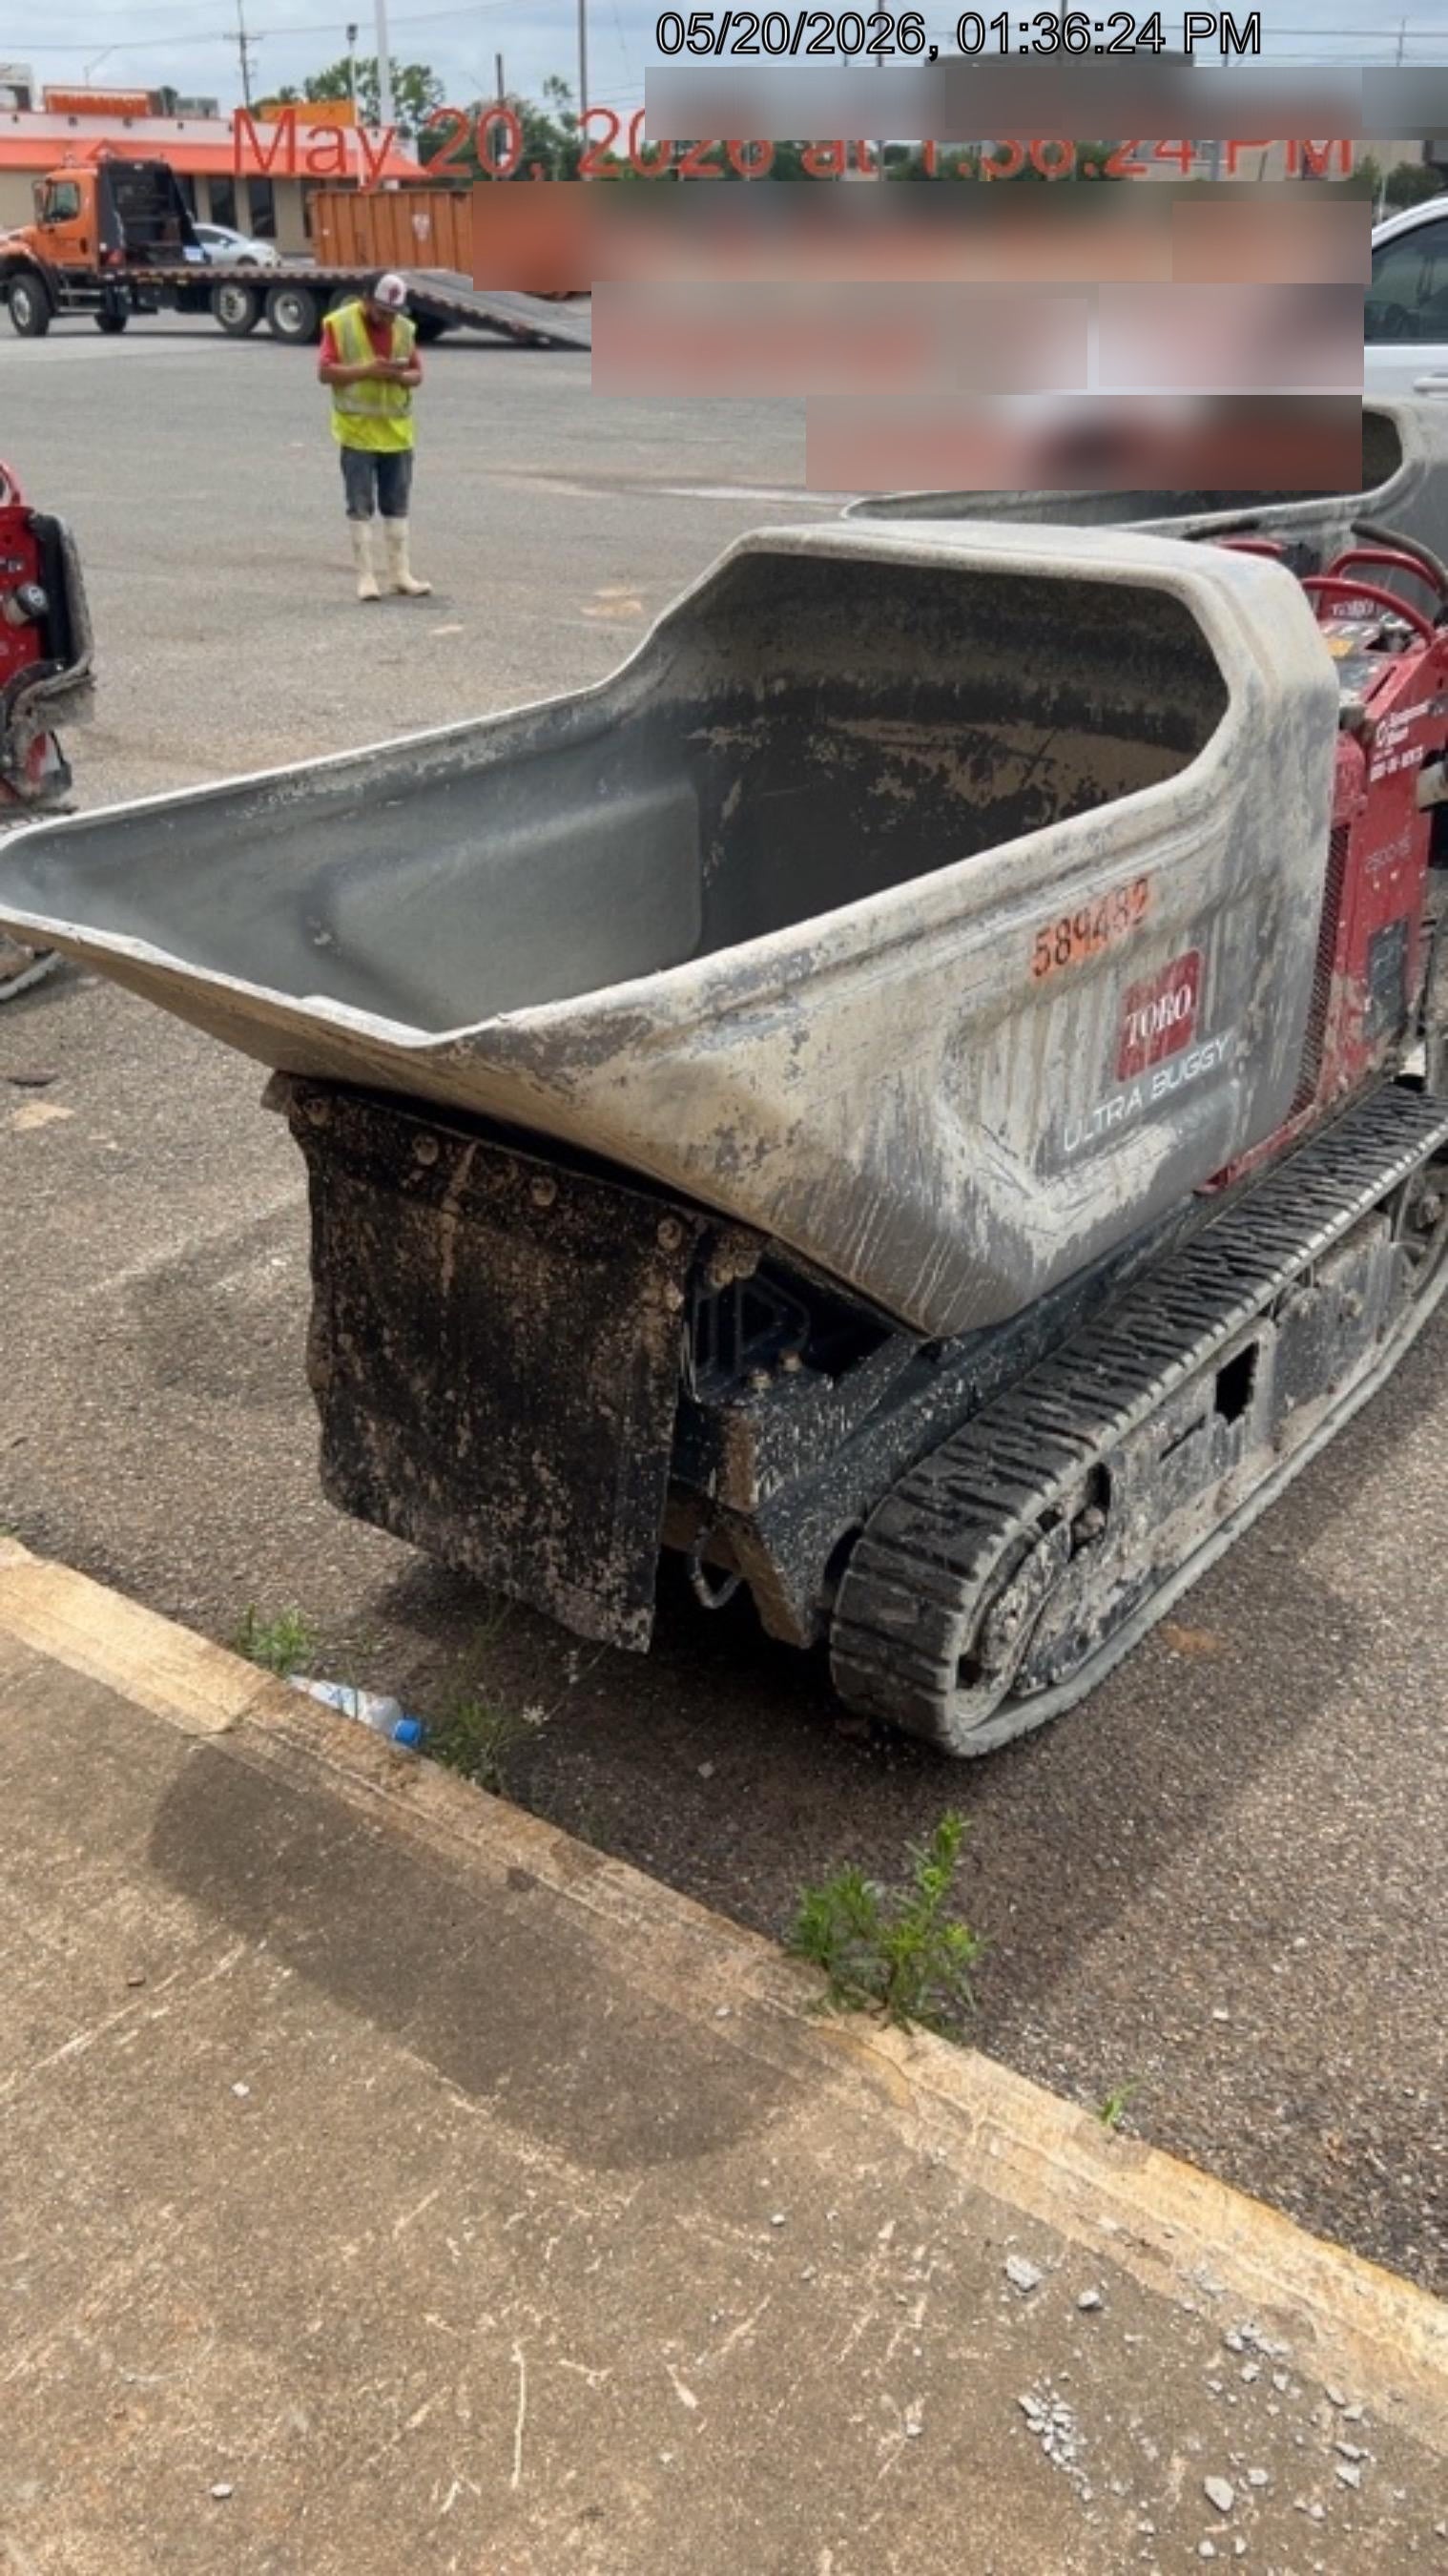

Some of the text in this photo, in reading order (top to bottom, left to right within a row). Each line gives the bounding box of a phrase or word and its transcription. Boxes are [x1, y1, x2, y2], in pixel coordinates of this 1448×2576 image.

[1032, 877, 1148, 977] 589482
[1126, 986, 1191, 1048] TORO
[1063, 1035, 1232, 1152] ULTRA BUGGY
